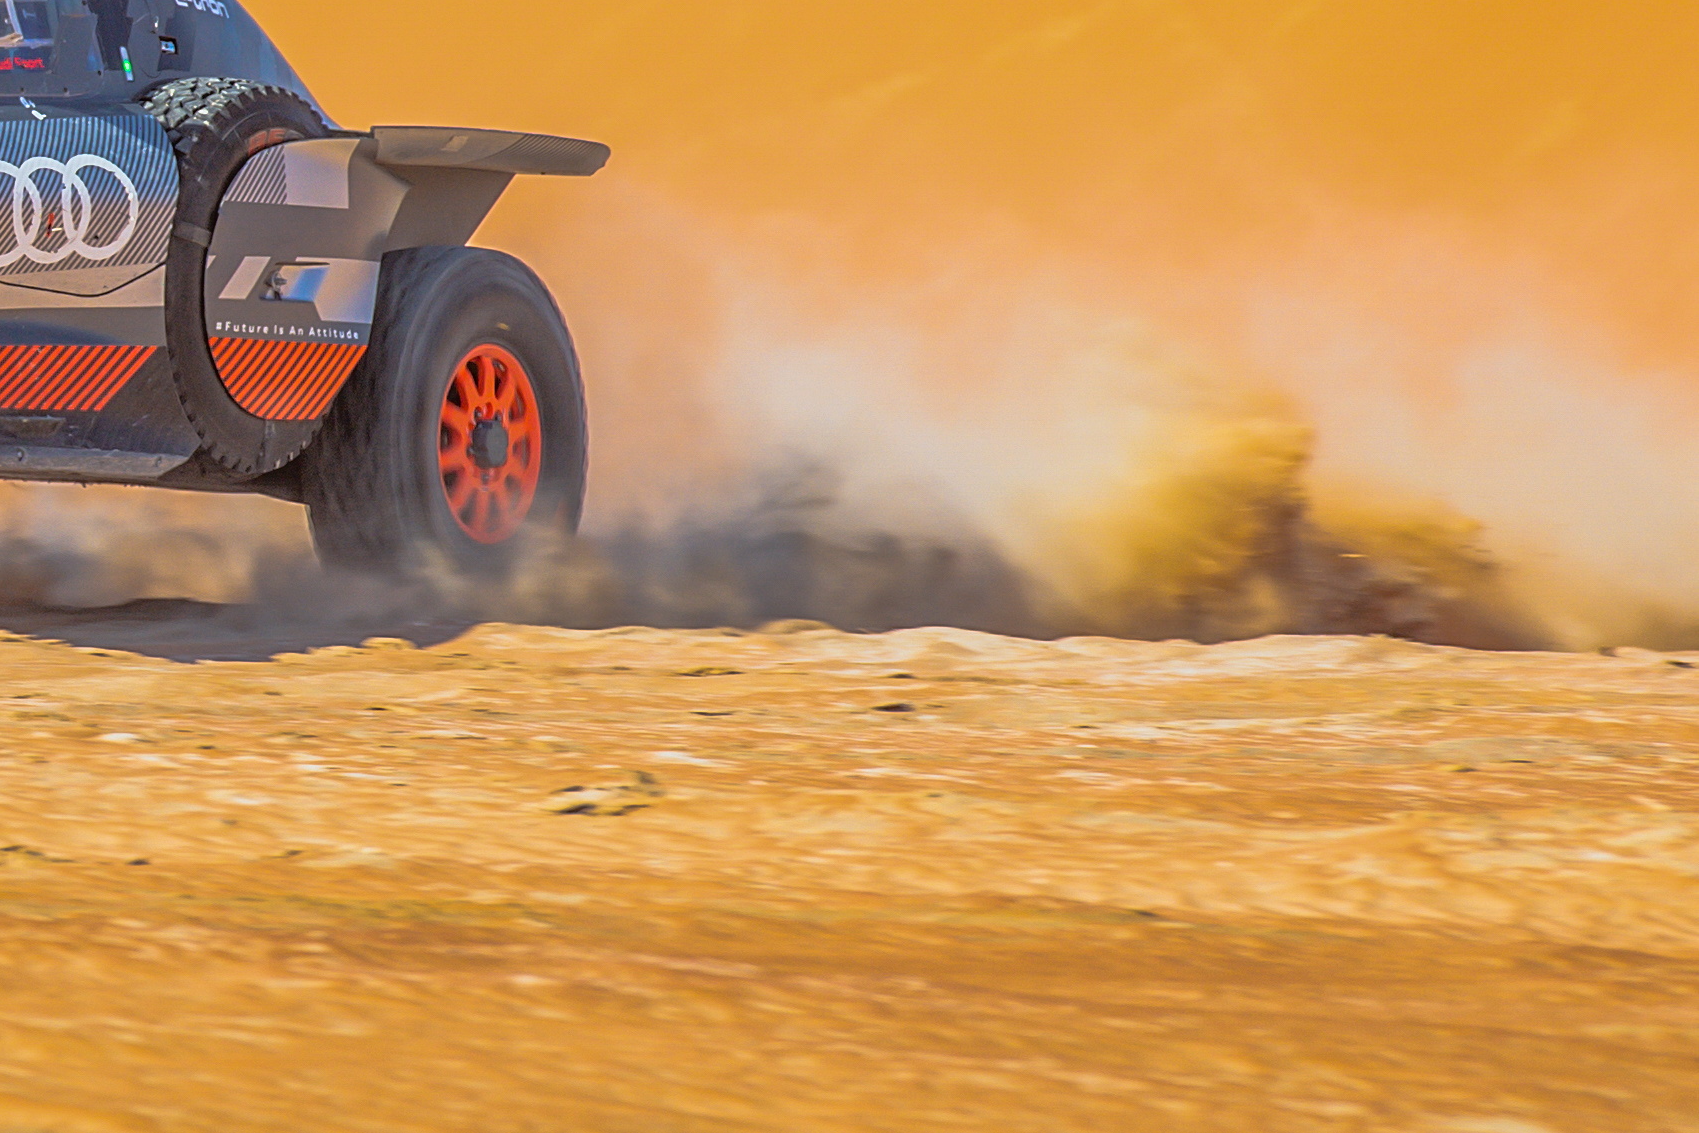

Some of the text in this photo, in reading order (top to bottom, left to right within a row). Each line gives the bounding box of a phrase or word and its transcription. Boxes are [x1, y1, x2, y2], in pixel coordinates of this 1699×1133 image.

[215, 320, 359, 340] #Future Is An Attitude
